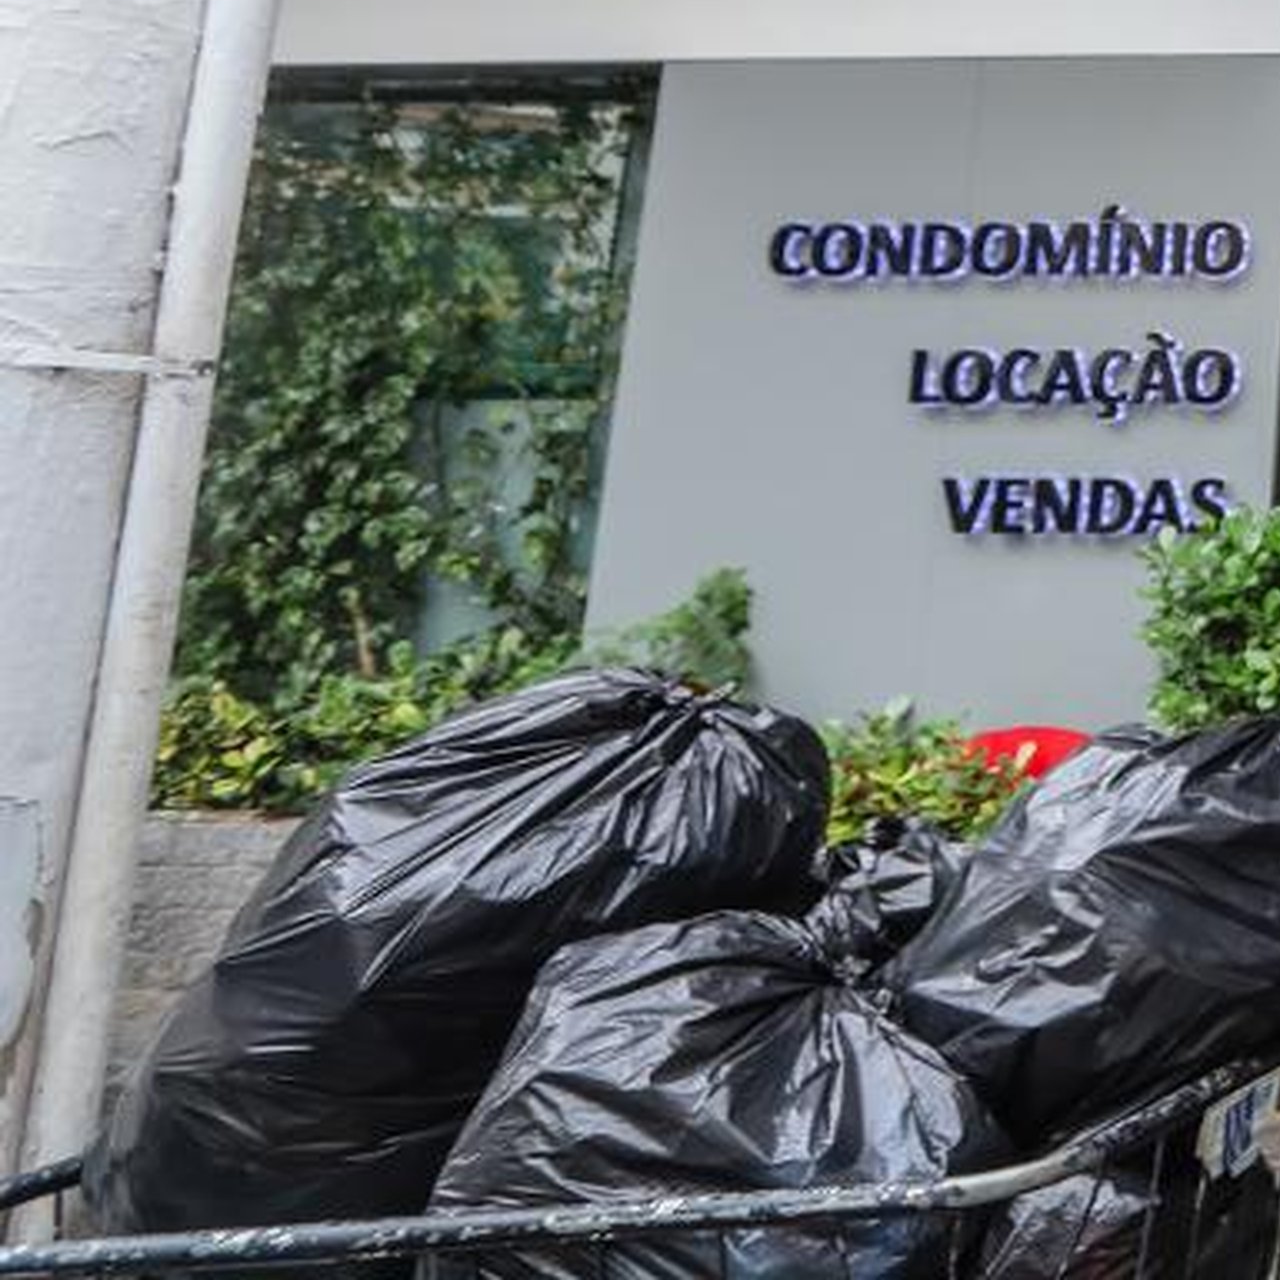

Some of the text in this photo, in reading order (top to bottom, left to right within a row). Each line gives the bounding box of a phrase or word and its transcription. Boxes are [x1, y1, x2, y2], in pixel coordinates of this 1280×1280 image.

[769, 205, 1247, 277] CONDOMÍNIO
[909, 332, 1237, 418] LOCAÇÃO
[943, 478, 1226, 535] VENDAS
